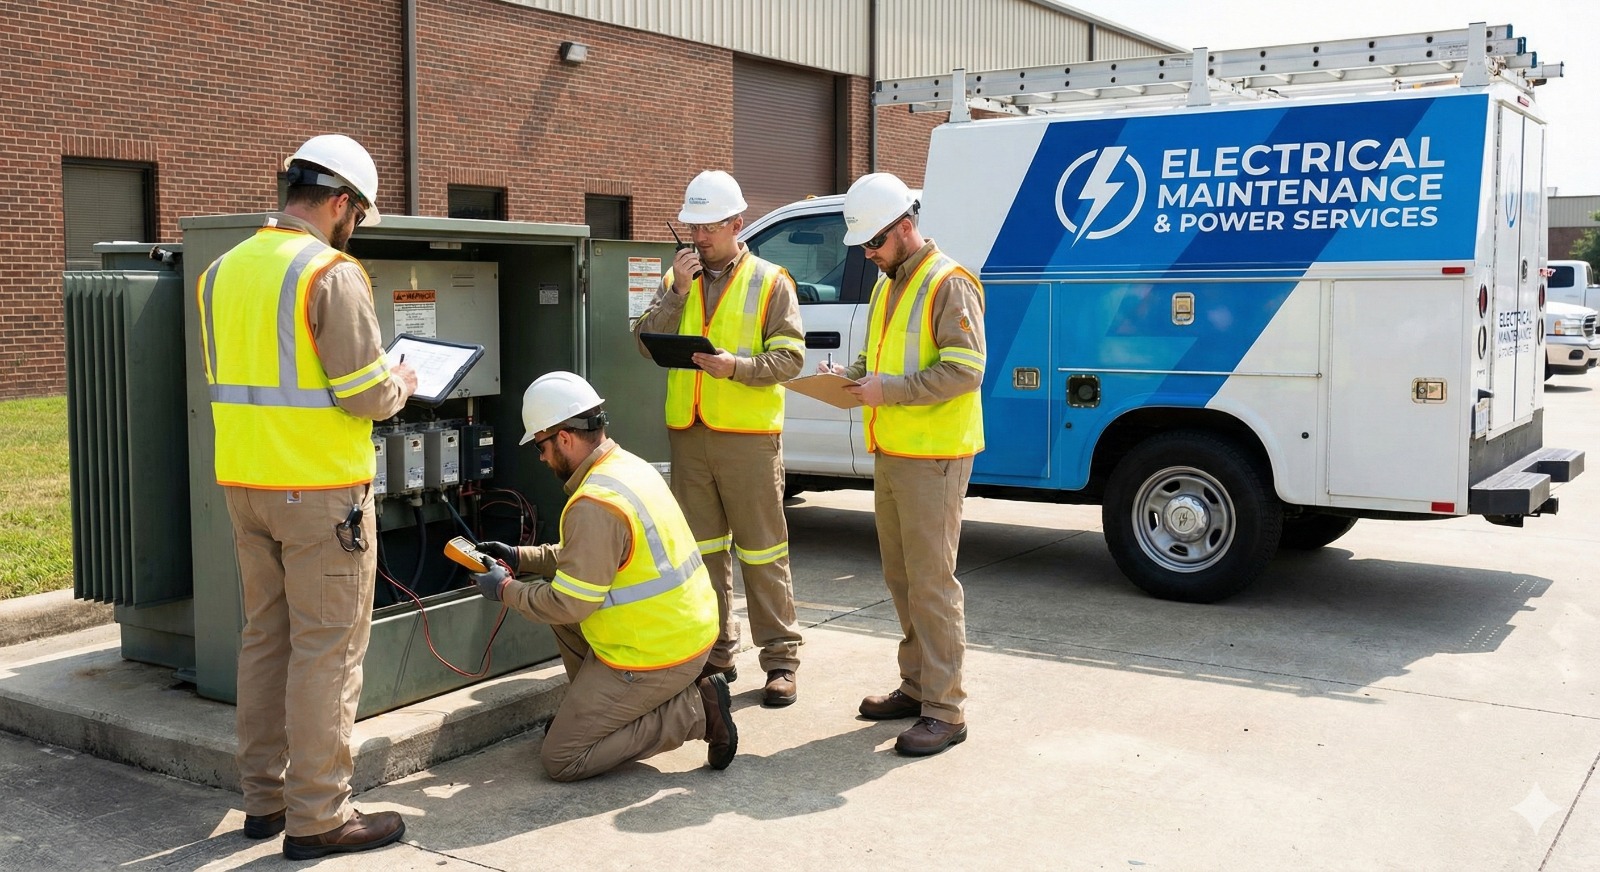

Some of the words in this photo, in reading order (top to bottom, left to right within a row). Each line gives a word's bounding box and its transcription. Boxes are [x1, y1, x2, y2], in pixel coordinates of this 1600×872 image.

[1161, 137, 1445, 178] ELECTRICAL
[1157, 173, 1444, 209] MAINTENANCE
[1154, 213, 1172, 233] &
[1180, 210, 1285, 232] POWER
[1293, 206, 1438, 230] SERVICES
